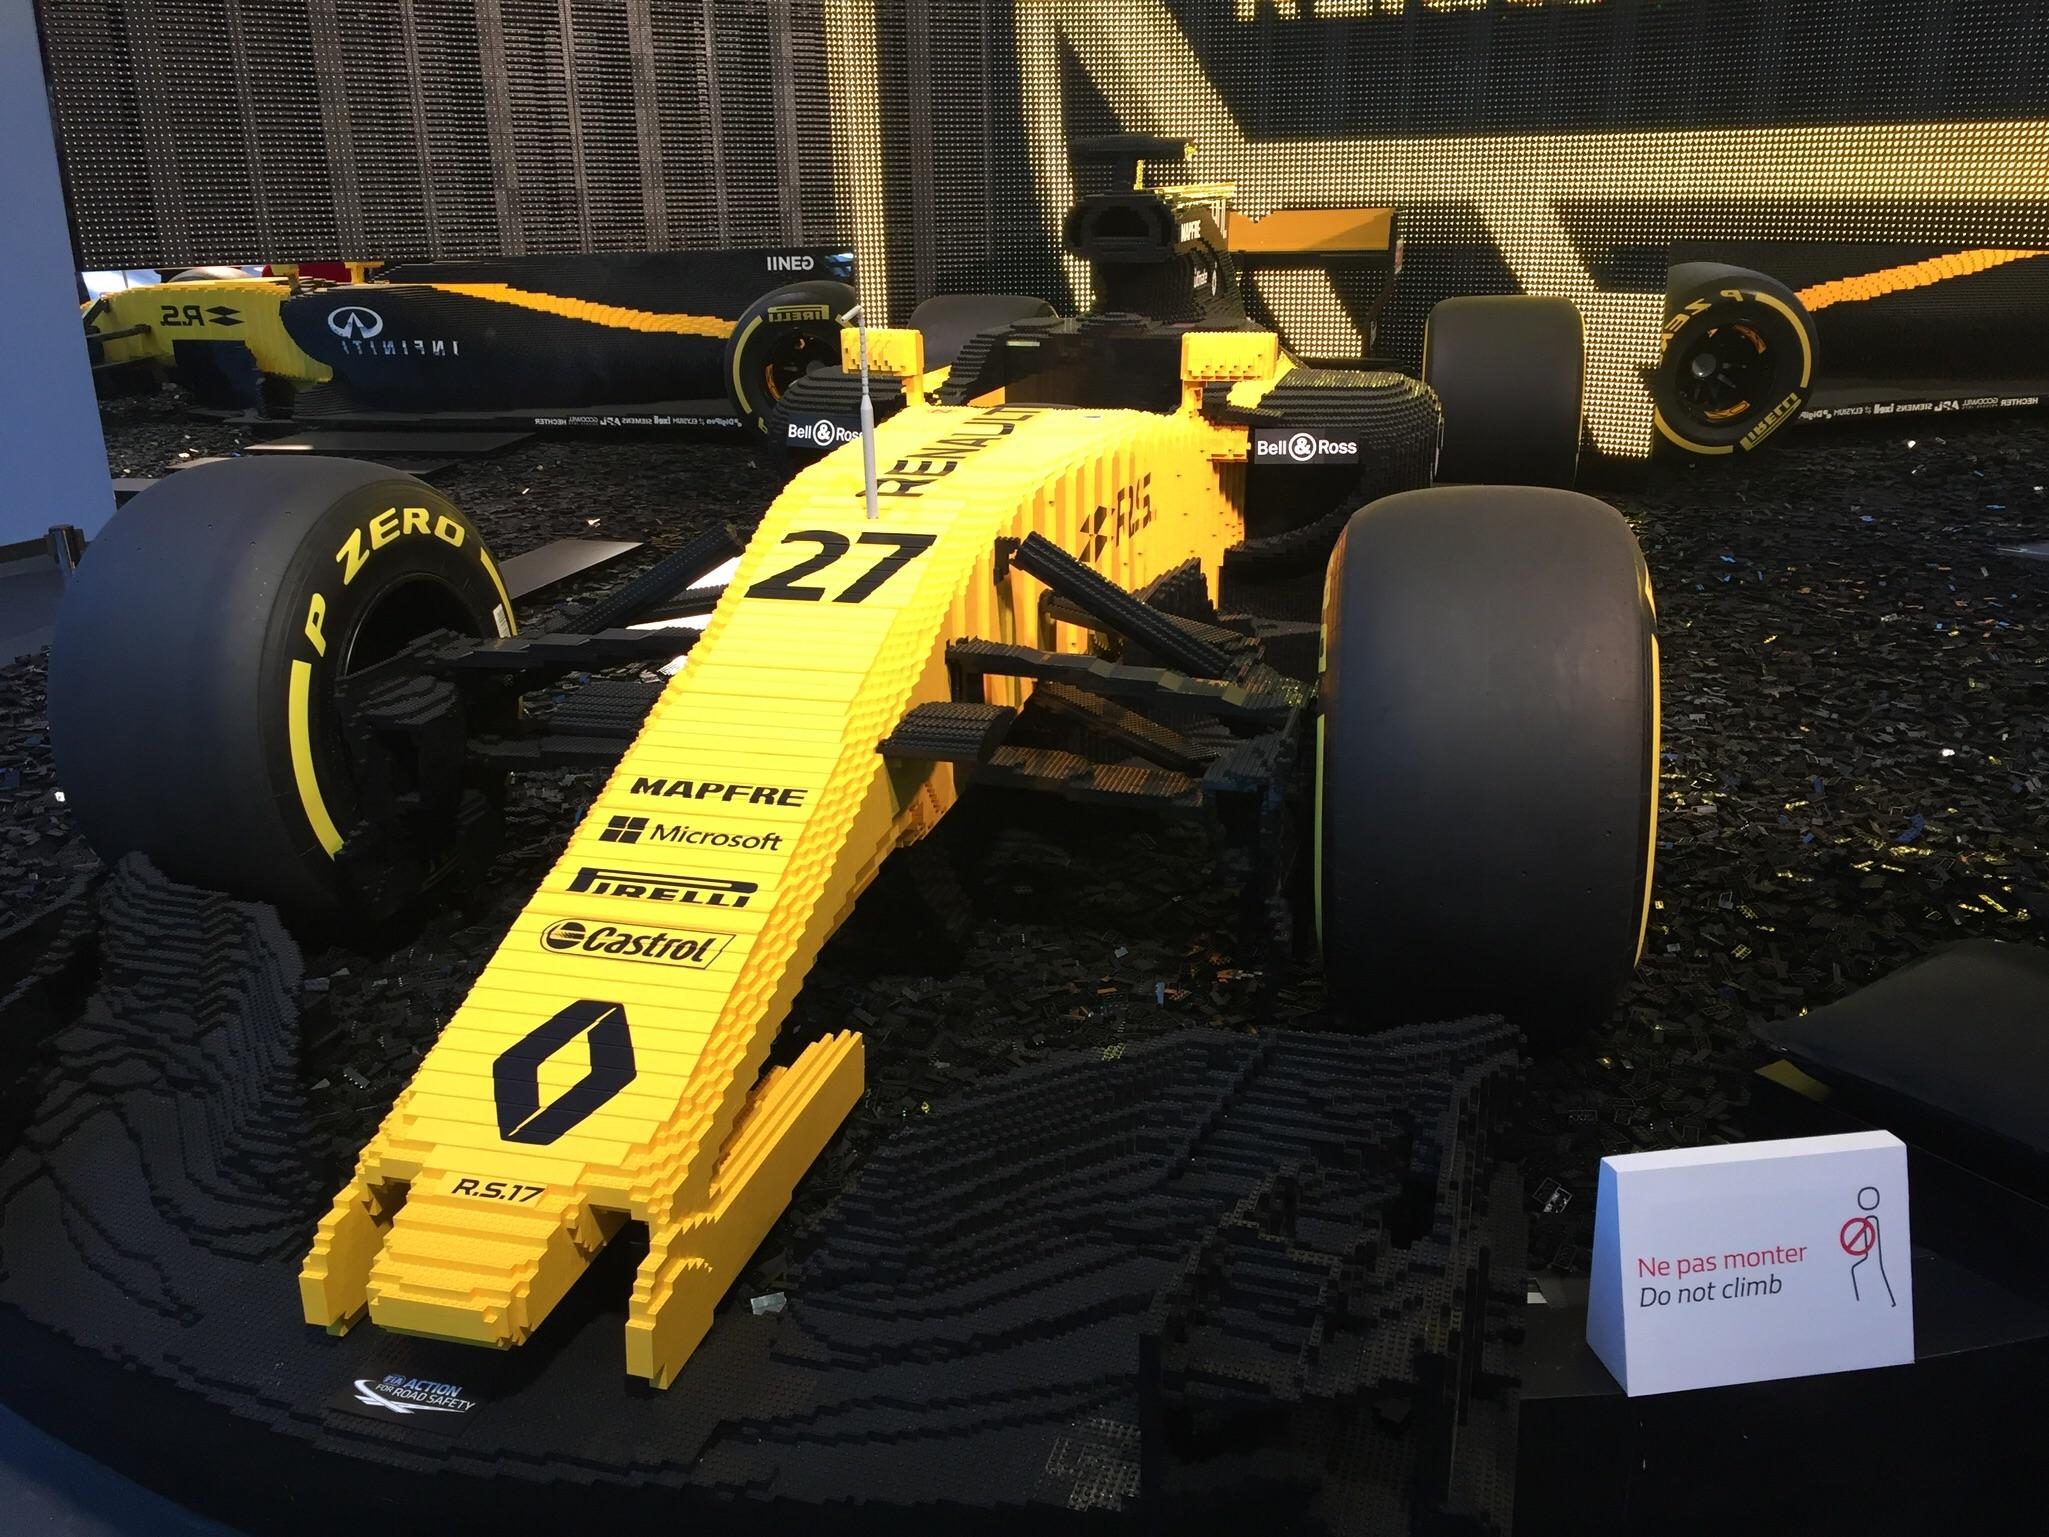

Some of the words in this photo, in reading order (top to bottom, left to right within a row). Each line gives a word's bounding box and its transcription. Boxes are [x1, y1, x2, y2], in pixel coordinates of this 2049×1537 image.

[788, 424, 811, 438] Bell
[1257, 440, 1287, 455] Bell
[1318, 439, 1358, 454] Ross
[855, 404, 1041, 497] RENAULT
[305, 593, 326, 657] P
[336, 507, 465, 585] ZERO
[744, 530, 938, 603] 27
[630, 777, 808, 807] MAPFRE
[649, 823, 782, 851] Microsoft
[566, 867, 758, 907] PIRELLI
[582, 927, 716, 962] Castrol
[451, 1178, 546, 1203] R.S.17
[1637, 1257, 1670, 1278] Ne
[1677, 1255, 1717, 1280] pas
[1724, 1245, 1808, 1270] monter
[1640, 1287, 1671, 1308] Do
[1678, 1281, 1716, 1304] not
[1722, 1274, 1783, 1300] climb
[375, 1383, 394, 1393] FOR
[391, 1387, 427, 1402] ROAD
[425, 1394, 476, 1411] SAFETY
[383, 1374, 406, 1387] FIA
[403, 1378, 462, 1397] ACTION
